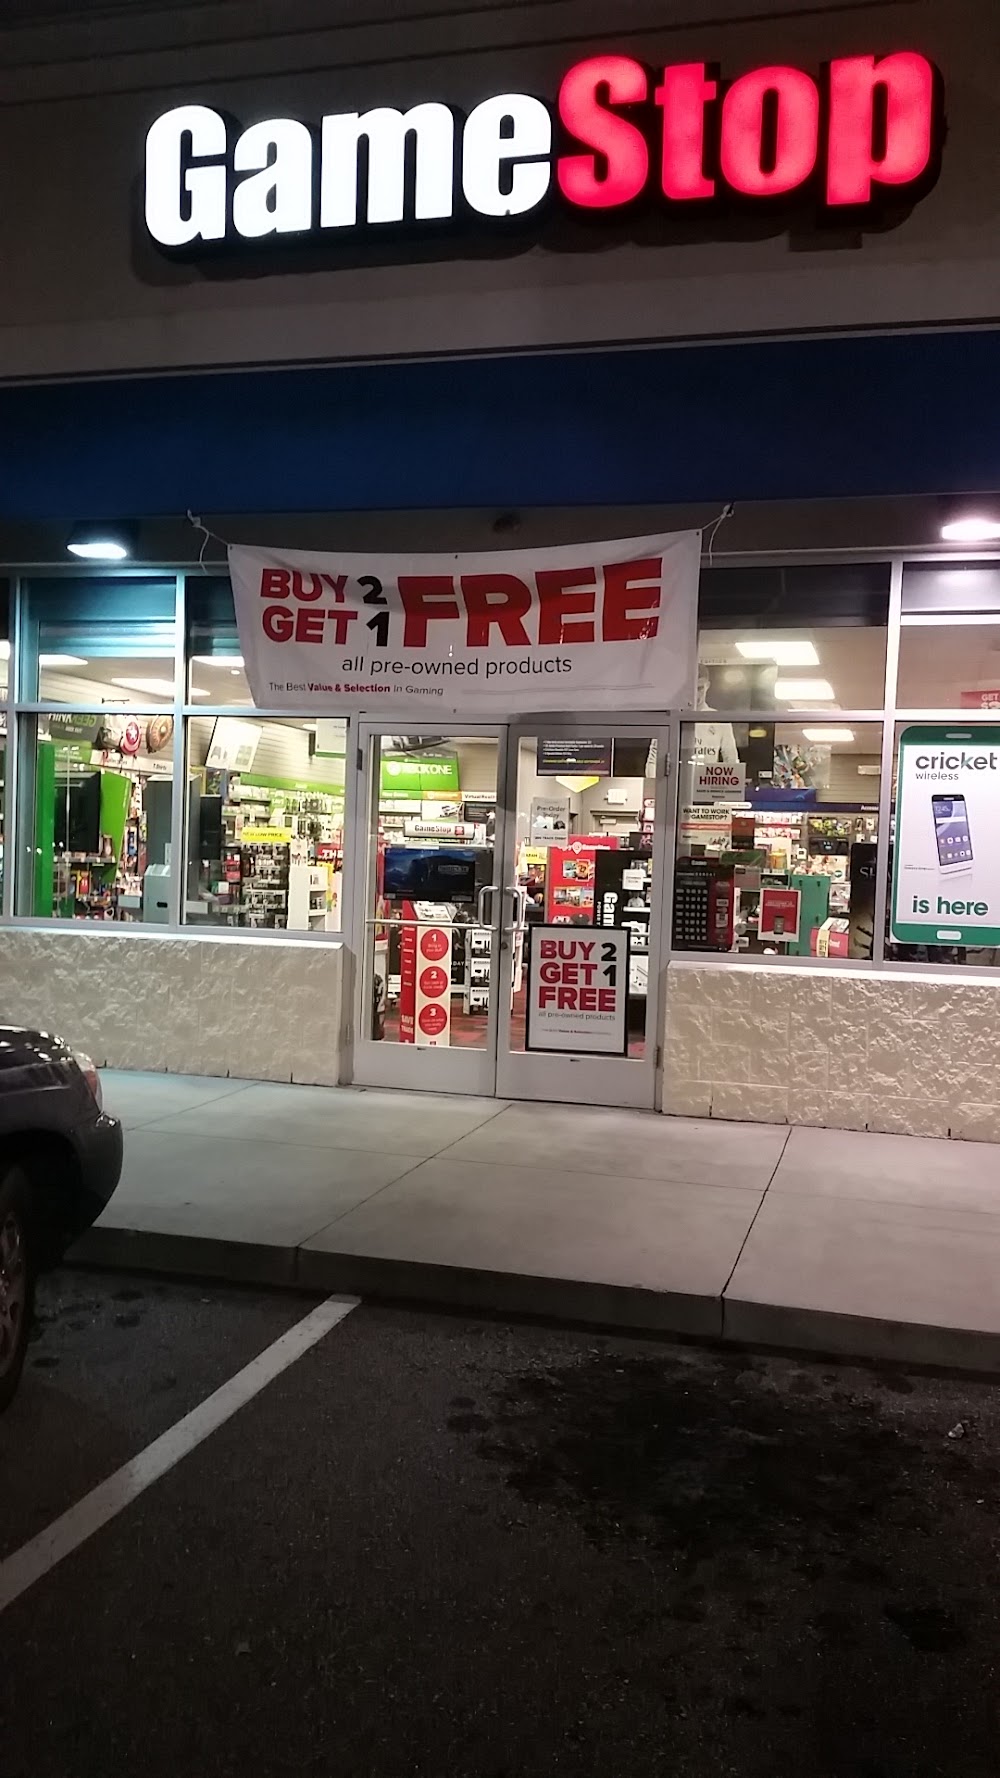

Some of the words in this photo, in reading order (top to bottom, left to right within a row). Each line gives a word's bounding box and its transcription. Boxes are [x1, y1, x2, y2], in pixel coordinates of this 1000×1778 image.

[145, 51, 933, 246] GameStop
[260, 568, 348, 603] BUY
[357, 575, 388, 605] 2
[397, 557, 663, 648] FREE
[262, 605, 358, 645] GET
[366, 611, 390, 647] 1
[341, 656, 364, 672] all
[370, 658, 479, 676] pre-owned
[486, 656, 572, 679] products
[269, 682, 285, 692] The
[286, 682, 306, 692] Best
[307, 683, 333, 693] Value
[335, 683, 342, 693] &
[344, 683, 391, 693] Selection
[405, 685, 444, 697] Gaming
[915, 751, 998, 770] cricket
[705, 766, 734, 776] NOW
[915, 771, 959, 780] wireless
[699, 776, 740, 786] HIRING
[710, 808, 730, 816] WORK
[414, 824, 452, 834] GameStop
[912, 895, 930, 914] is
[937, 896, 989, 916] here
[431, 933, 437, 942] 1
[540, 940, 596, 961] BUY
[601, 942, 617, 962] 2
[430, 971, 438, 979] 2
[540, 962, 598, 986] GET
[603, 964, 617, 987] 1
[538, 985, 617, 1013] FREE
[429, 1008, 437, 1016] 3
[547, 1011, 584, 1020] pre-owned
[585, 1012, 616, 1022] products
